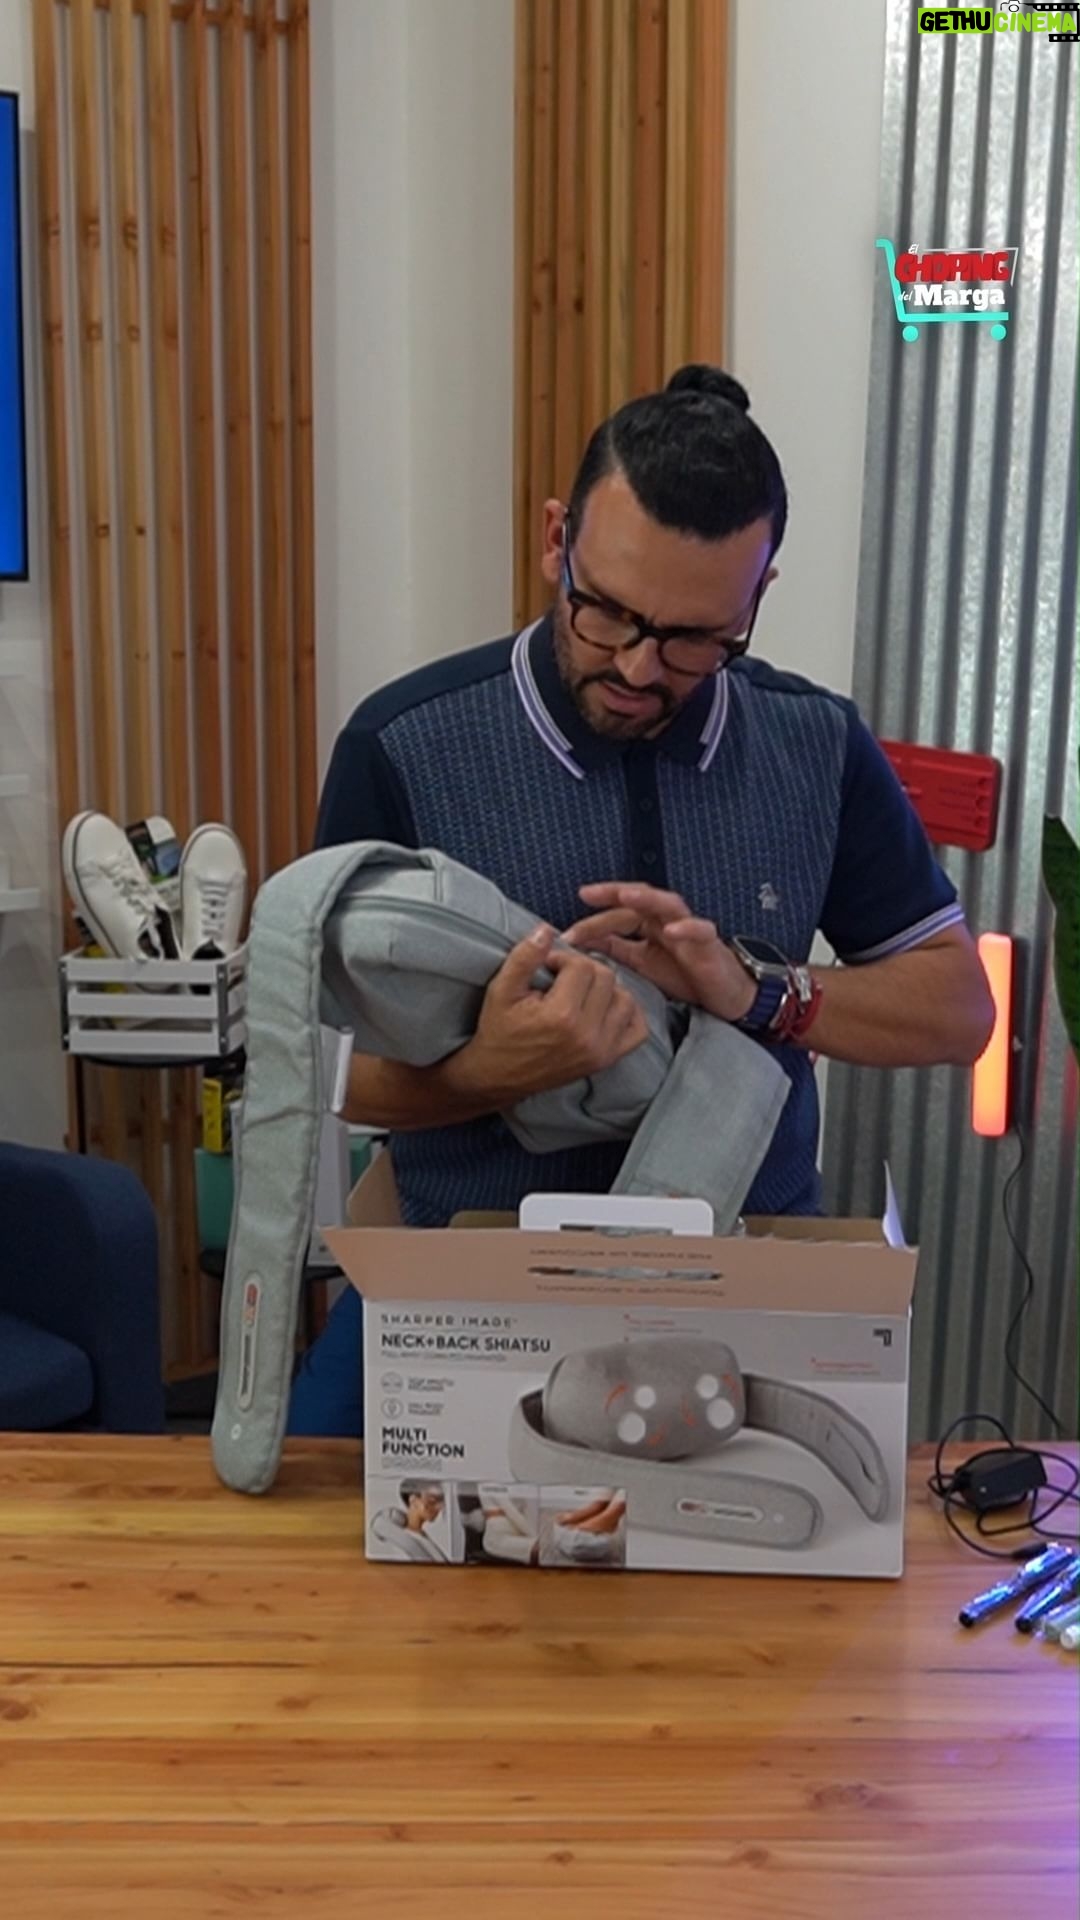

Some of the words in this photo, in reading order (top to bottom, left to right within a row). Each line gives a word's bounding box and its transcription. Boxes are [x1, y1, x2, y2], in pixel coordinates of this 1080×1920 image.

[381, 1313, 454, 1326] SHARPER
[381, 1333, 479, 1350] NECK+BACK
[484, 1336, 551, 1353] SHIATSU
[382, 1426, 427, 1441] MULTI
[382, 1441, 465, 1458] FUNCTION
